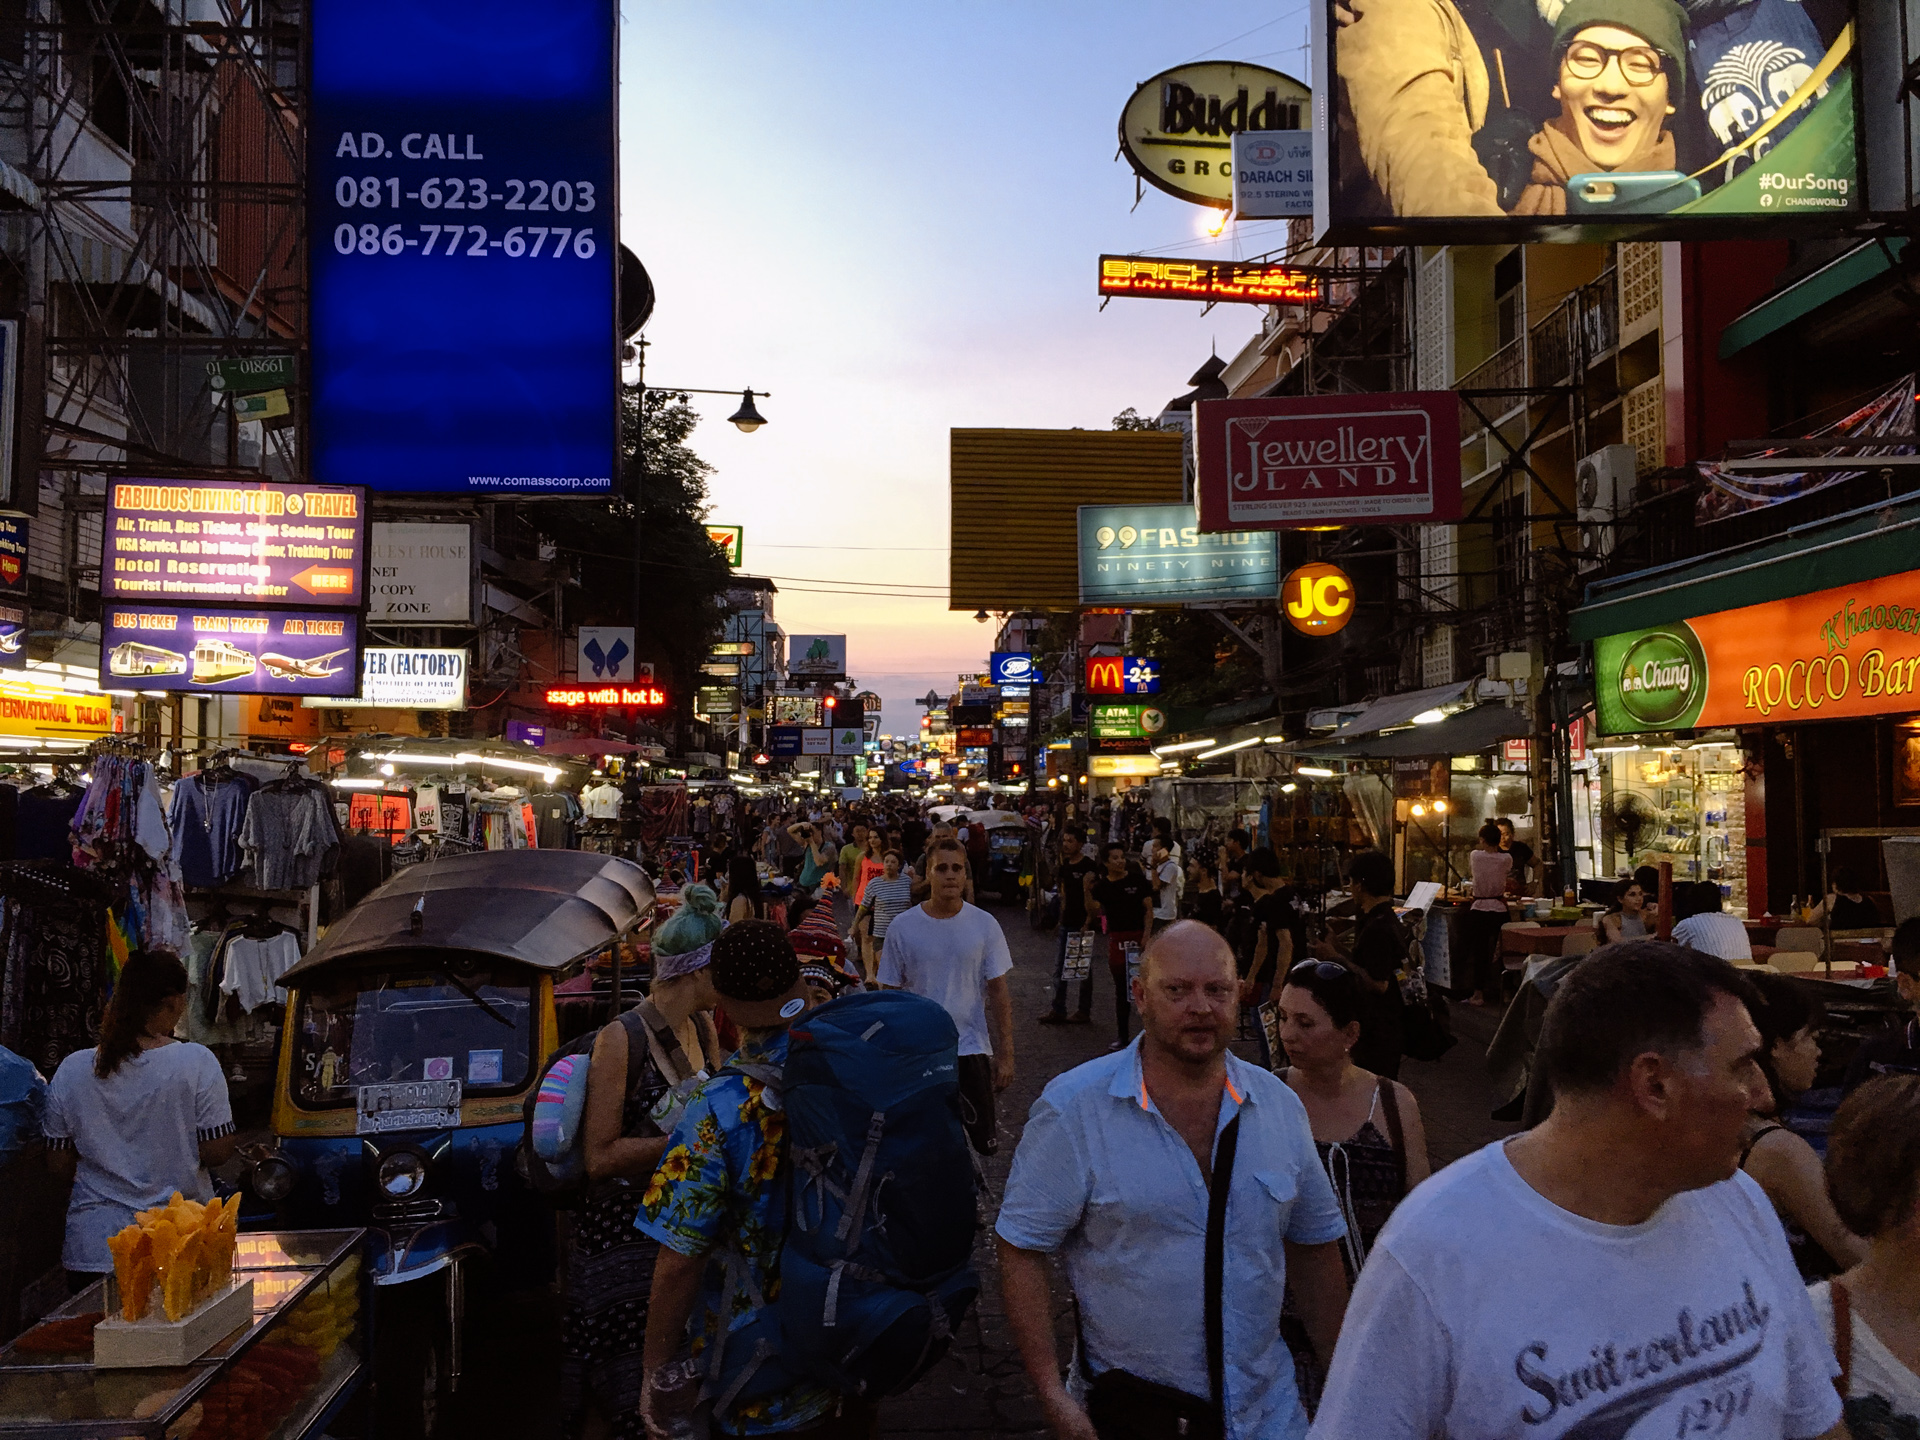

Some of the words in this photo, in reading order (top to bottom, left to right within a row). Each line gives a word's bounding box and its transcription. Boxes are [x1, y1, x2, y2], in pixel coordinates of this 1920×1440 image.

[335, 132, 393, 159] AD.
[401, 133, 484, 160] CALL
[1240, 171, 1292, 184] DARACH
[1759, 172, 1848, 194] #OurSong
[335, 175, 596, 212] 081-623-2203
[1265, 190, 1300, 198] STERING
[1785, 197, 1848, 207] CHANGWORLD
[333, 223, 596, 259] 086-772-6776
[468, 476, 611, 489] www.comasscorp.com
[1265, 466, 1397, 491] LAND
[114, 485, 190, 511] FABULOUS
[190, 488, 243, 514] DIVING
[244, 490, 285, 516] TOUR
[304, 492, 358, 518] TRAVEL
[116, 517, 135, 532] Air,
[138, 518, 174, 534] Train,
[175, 519, 200, 534] Bus
[281, 524, 325, 540] Seeing
[326, 525, 355, 540] Tour
[116, 538, 138, 552] VISA
[287, 544, 330, 560] Trekking
[332, 546, 353, 559] Tour
[420, 545, 466, 559] HOUSE
[2, 558, 19, 574] Here
[115, 558, 160, 573] Hotel
[167, 560, 271, 577] Reservation
[1097, 560, 1190, 572] NINETY
[1211, 556, 1271, 568] NINE
[114, 578, 161, 592] Tourist
[163, 580, 241, 594] Information
[243, 582, 288, 596] Center
[311, 574, 347, 588] HERE
[380, 584, 416, 596] COPY
[1288, 576, 1350, 618] JC
[387, 603, 431, 613] ZONE
[113, 613, 137, 628] BUS
[138, 614, 178, 630] TICKET
[193, 616, 229, 632] TRAIN
[230, 617, 269, 634] TICKET
[283, 619, 304, 635] AIR
[306, 620, 344, 636] TICKET
[390, 652, 463, 680] (FACTORY)
[1129, 667, 1152, 683] 24
[1642, 660, 1690, 691] Chang
[1743, 654, 1850, 716] ROCCO
[1858, 648, 1920, 698] Bar
[588, 688, 618, 703] with
[622, 688, 647, 704] hot
[75, 705, 108, 727] TAILOR
[1106, 708, 1129, 717] ATM
